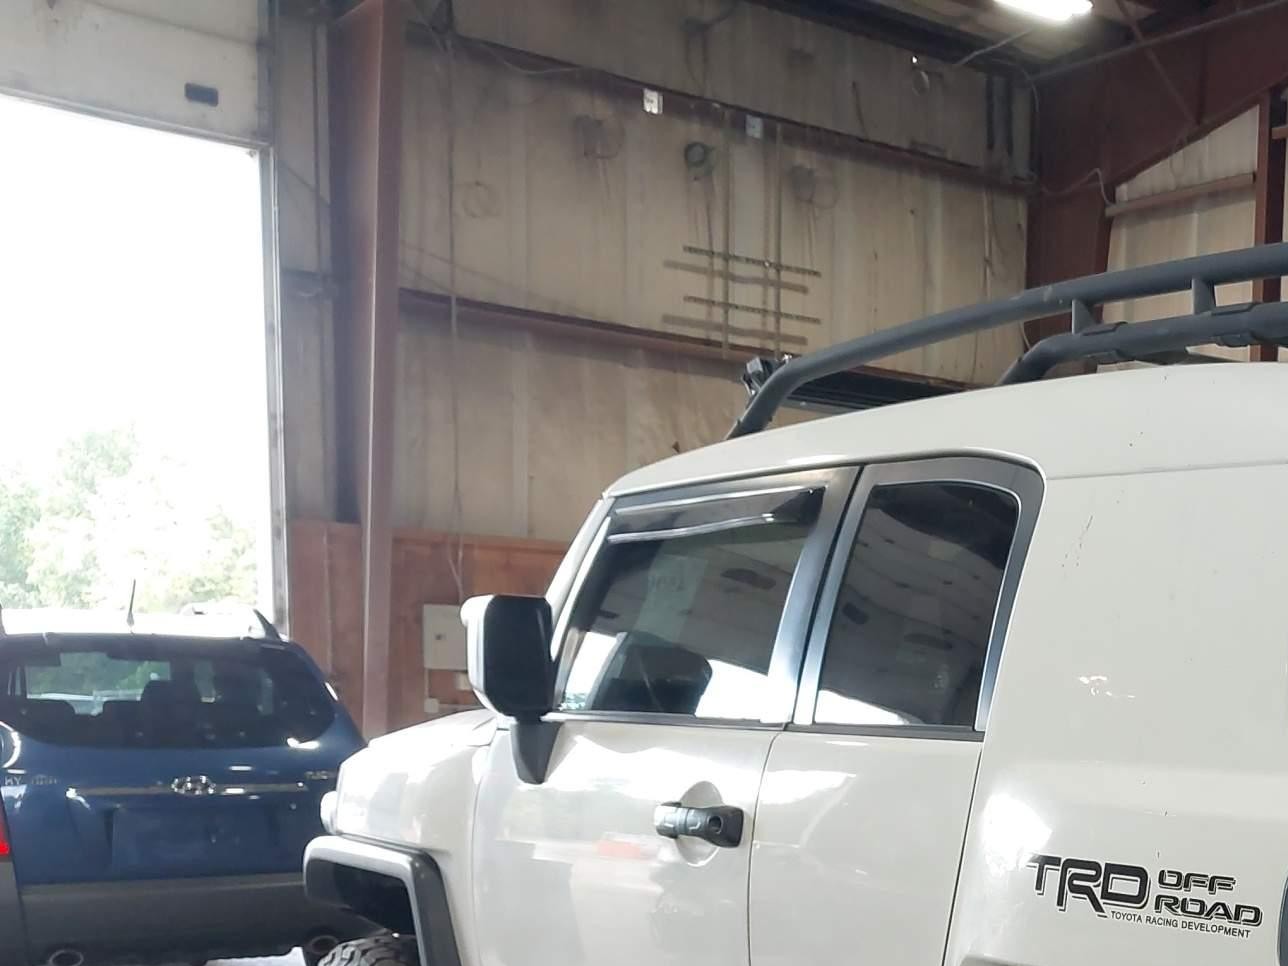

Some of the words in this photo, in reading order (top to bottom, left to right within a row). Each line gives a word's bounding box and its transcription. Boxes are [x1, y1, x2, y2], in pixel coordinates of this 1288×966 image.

[1026, 854, 1150, 918] TRD
[1157, 869, 1236, 895] OFF
[1111, 910, 1143, 923] TOYOTA
[1145, 915, 1179, 929] RACING
[1181, 920, 1251, 939] DEVELOPMENT
[1154, 894, 1263, 927] ROAD
